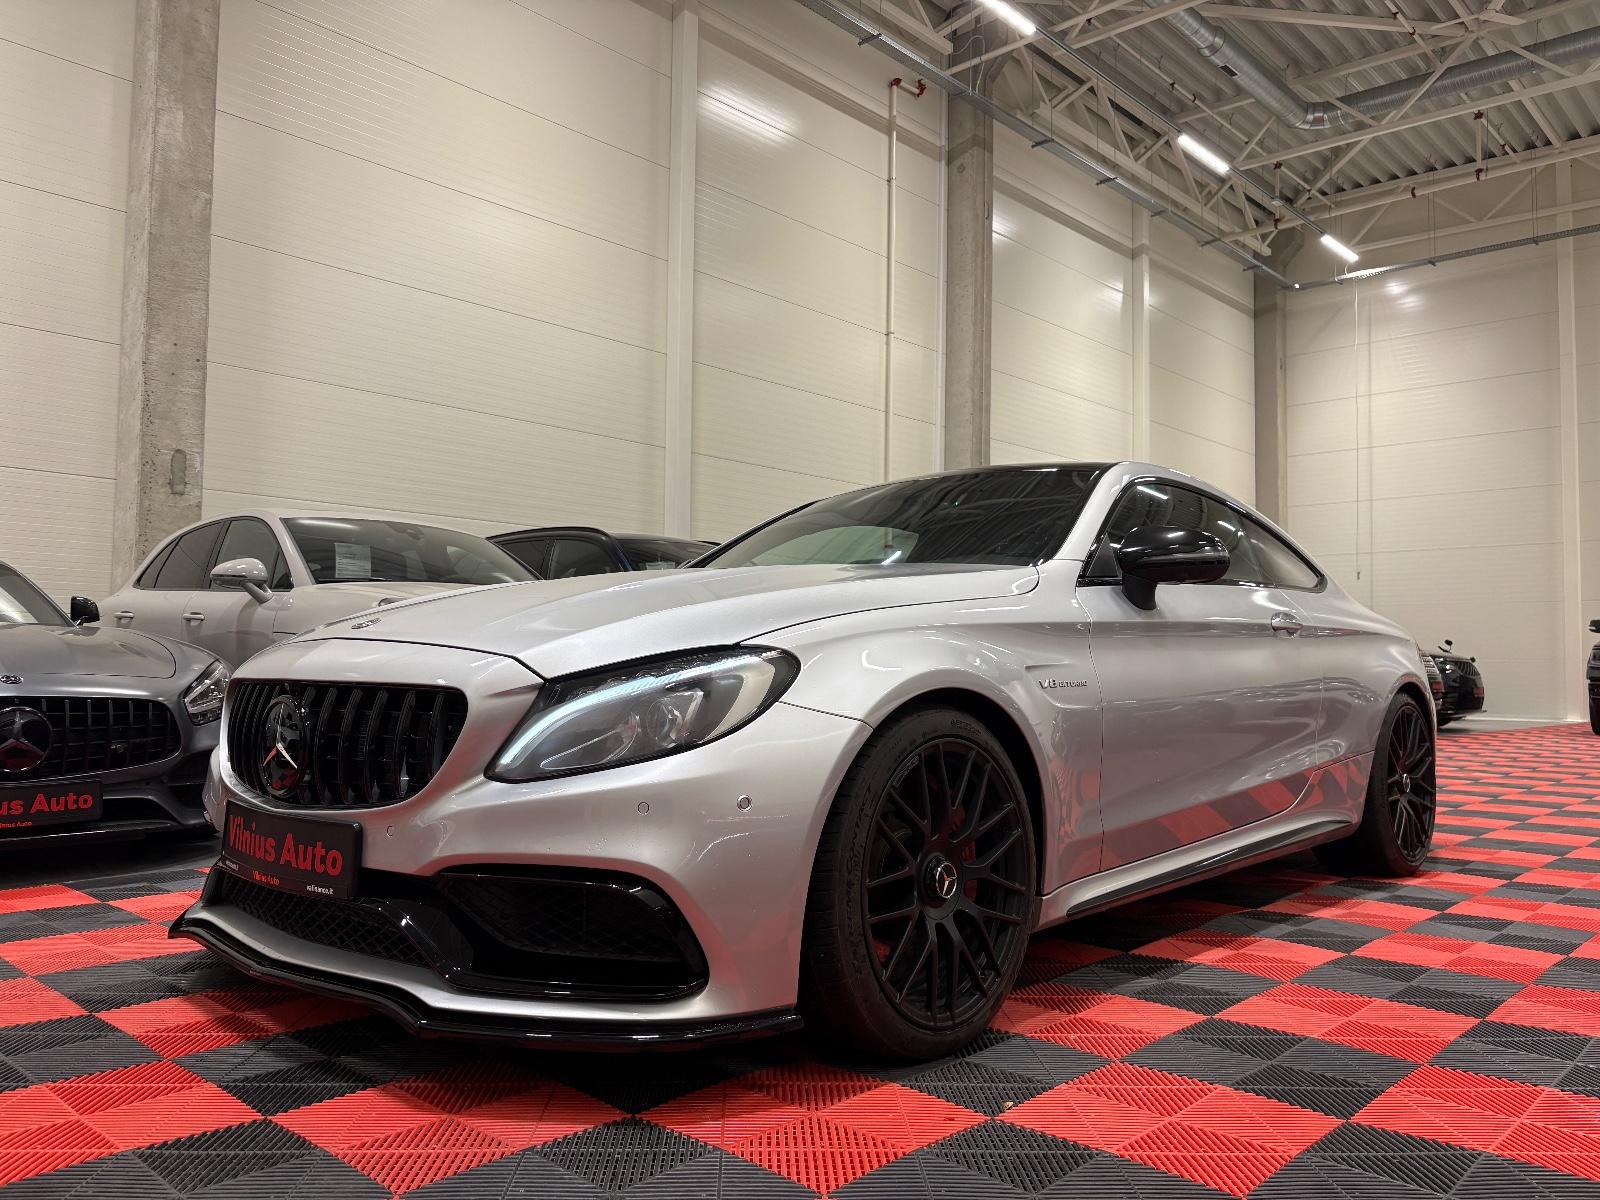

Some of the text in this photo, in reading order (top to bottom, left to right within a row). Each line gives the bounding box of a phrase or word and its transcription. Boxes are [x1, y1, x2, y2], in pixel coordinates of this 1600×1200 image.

[1038, 679, 1057, 689] V8
[29, 792, 94, 814] Auto
[229, 814, 343, 876] Vilnius Auto
